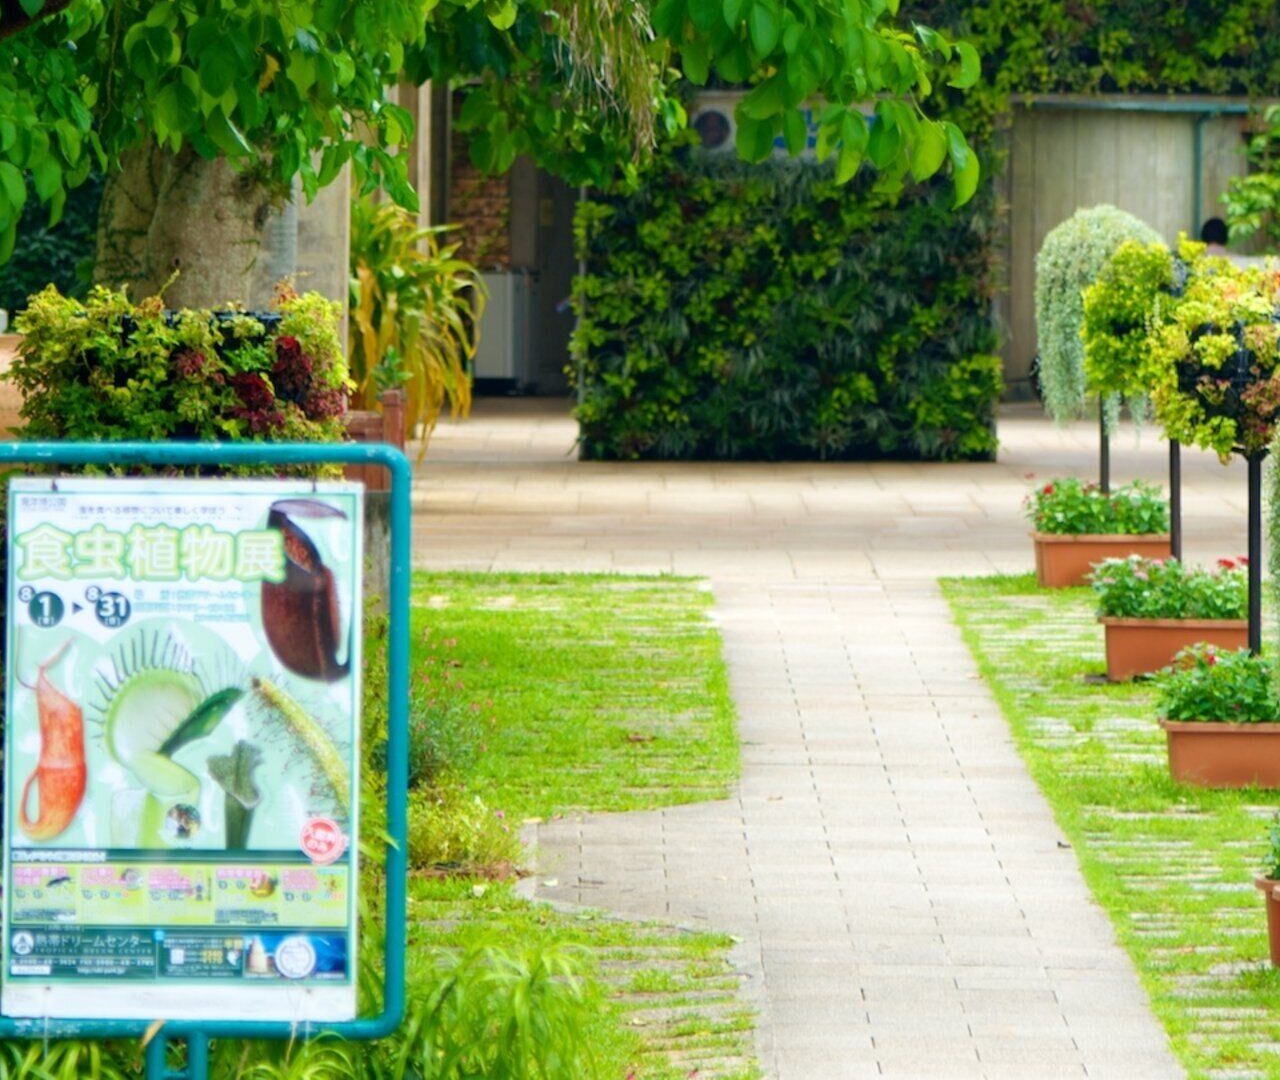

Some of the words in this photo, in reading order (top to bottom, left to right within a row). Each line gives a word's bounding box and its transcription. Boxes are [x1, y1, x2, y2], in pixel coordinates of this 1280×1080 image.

[19, 524, 284, 580] 食虫植物展
[21, 587, 32, 601] 8
[88, 587, 99, 601] 8
[38, 596, 51, 617] 1
[99, 596, 127, 617] 31
[35, 934, 152, 948] 熱帯ドリームセンター
